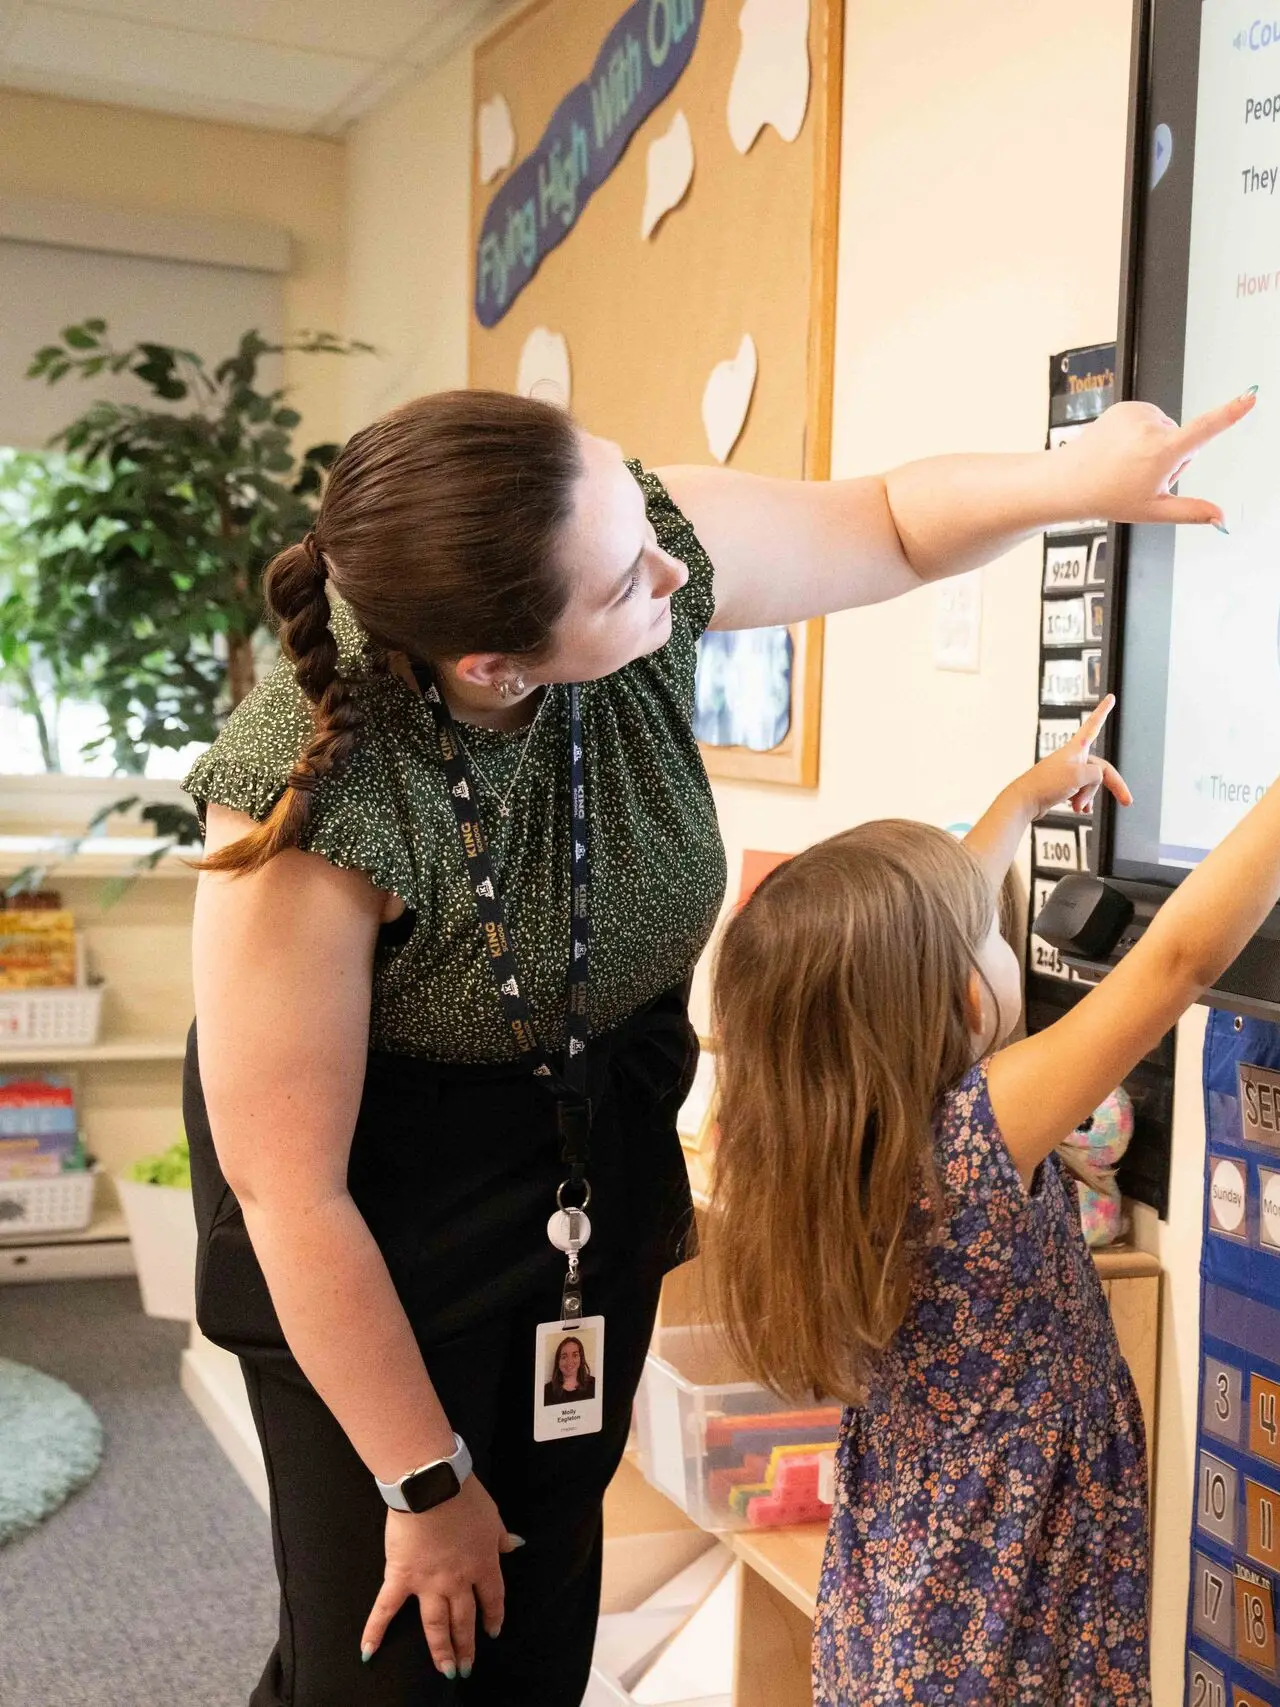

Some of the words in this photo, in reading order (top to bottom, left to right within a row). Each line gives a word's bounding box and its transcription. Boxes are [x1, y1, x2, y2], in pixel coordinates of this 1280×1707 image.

[1242, 165, 1278, 195] They
[480, 197, 536, 305] Flying
[538, 120, 588, 230] High
[1236, 272, 1270, 299] How
[1052, 560, 1080, 581] 9:20
[1211, 775, 1250, 803] There
[461, 822, 478, 858] KING
[1042, 842, 1071, 861] 1:00
[485, 921, 502, 959] KING
[511, 1019, 532, 1051] KING
[1212, 1184, 1243, 1207] Sunday
[1214, 1372, 1230, 1421] 3
[1258, 1392, 1277, 1445] 4
[1203, 1467, 1228, 1522] 10
[1259, 1498, 1273, 1551] 11
[1203, 1569, 1224, 1624] 17
[1244, 1592, 1268, 1648] 18
